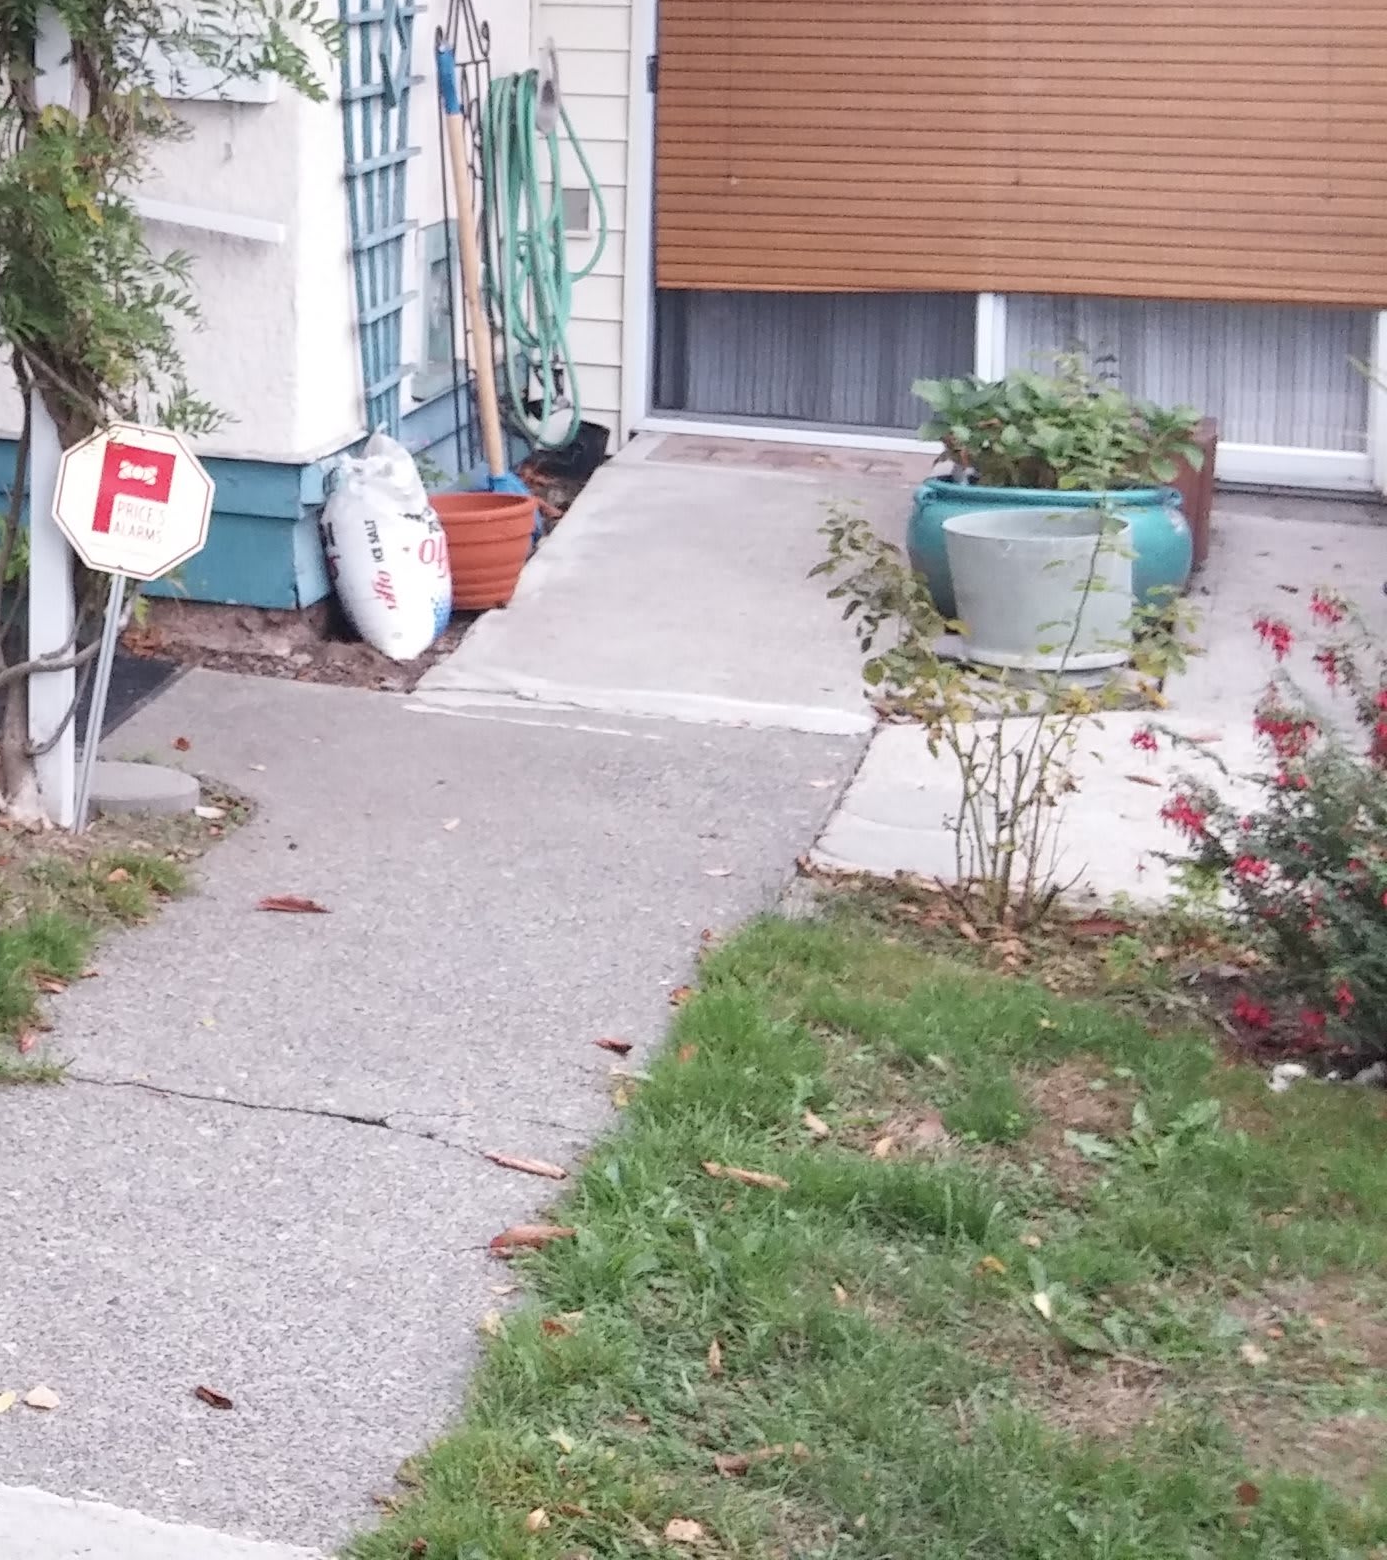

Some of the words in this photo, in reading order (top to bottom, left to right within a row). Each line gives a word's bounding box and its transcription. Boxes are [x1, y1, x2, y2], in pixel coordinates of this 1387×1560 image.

[91, 440, 177, 534] P
[112, 521, 164, 544] ALARMS
[364, 520, 380, 544] SALT
